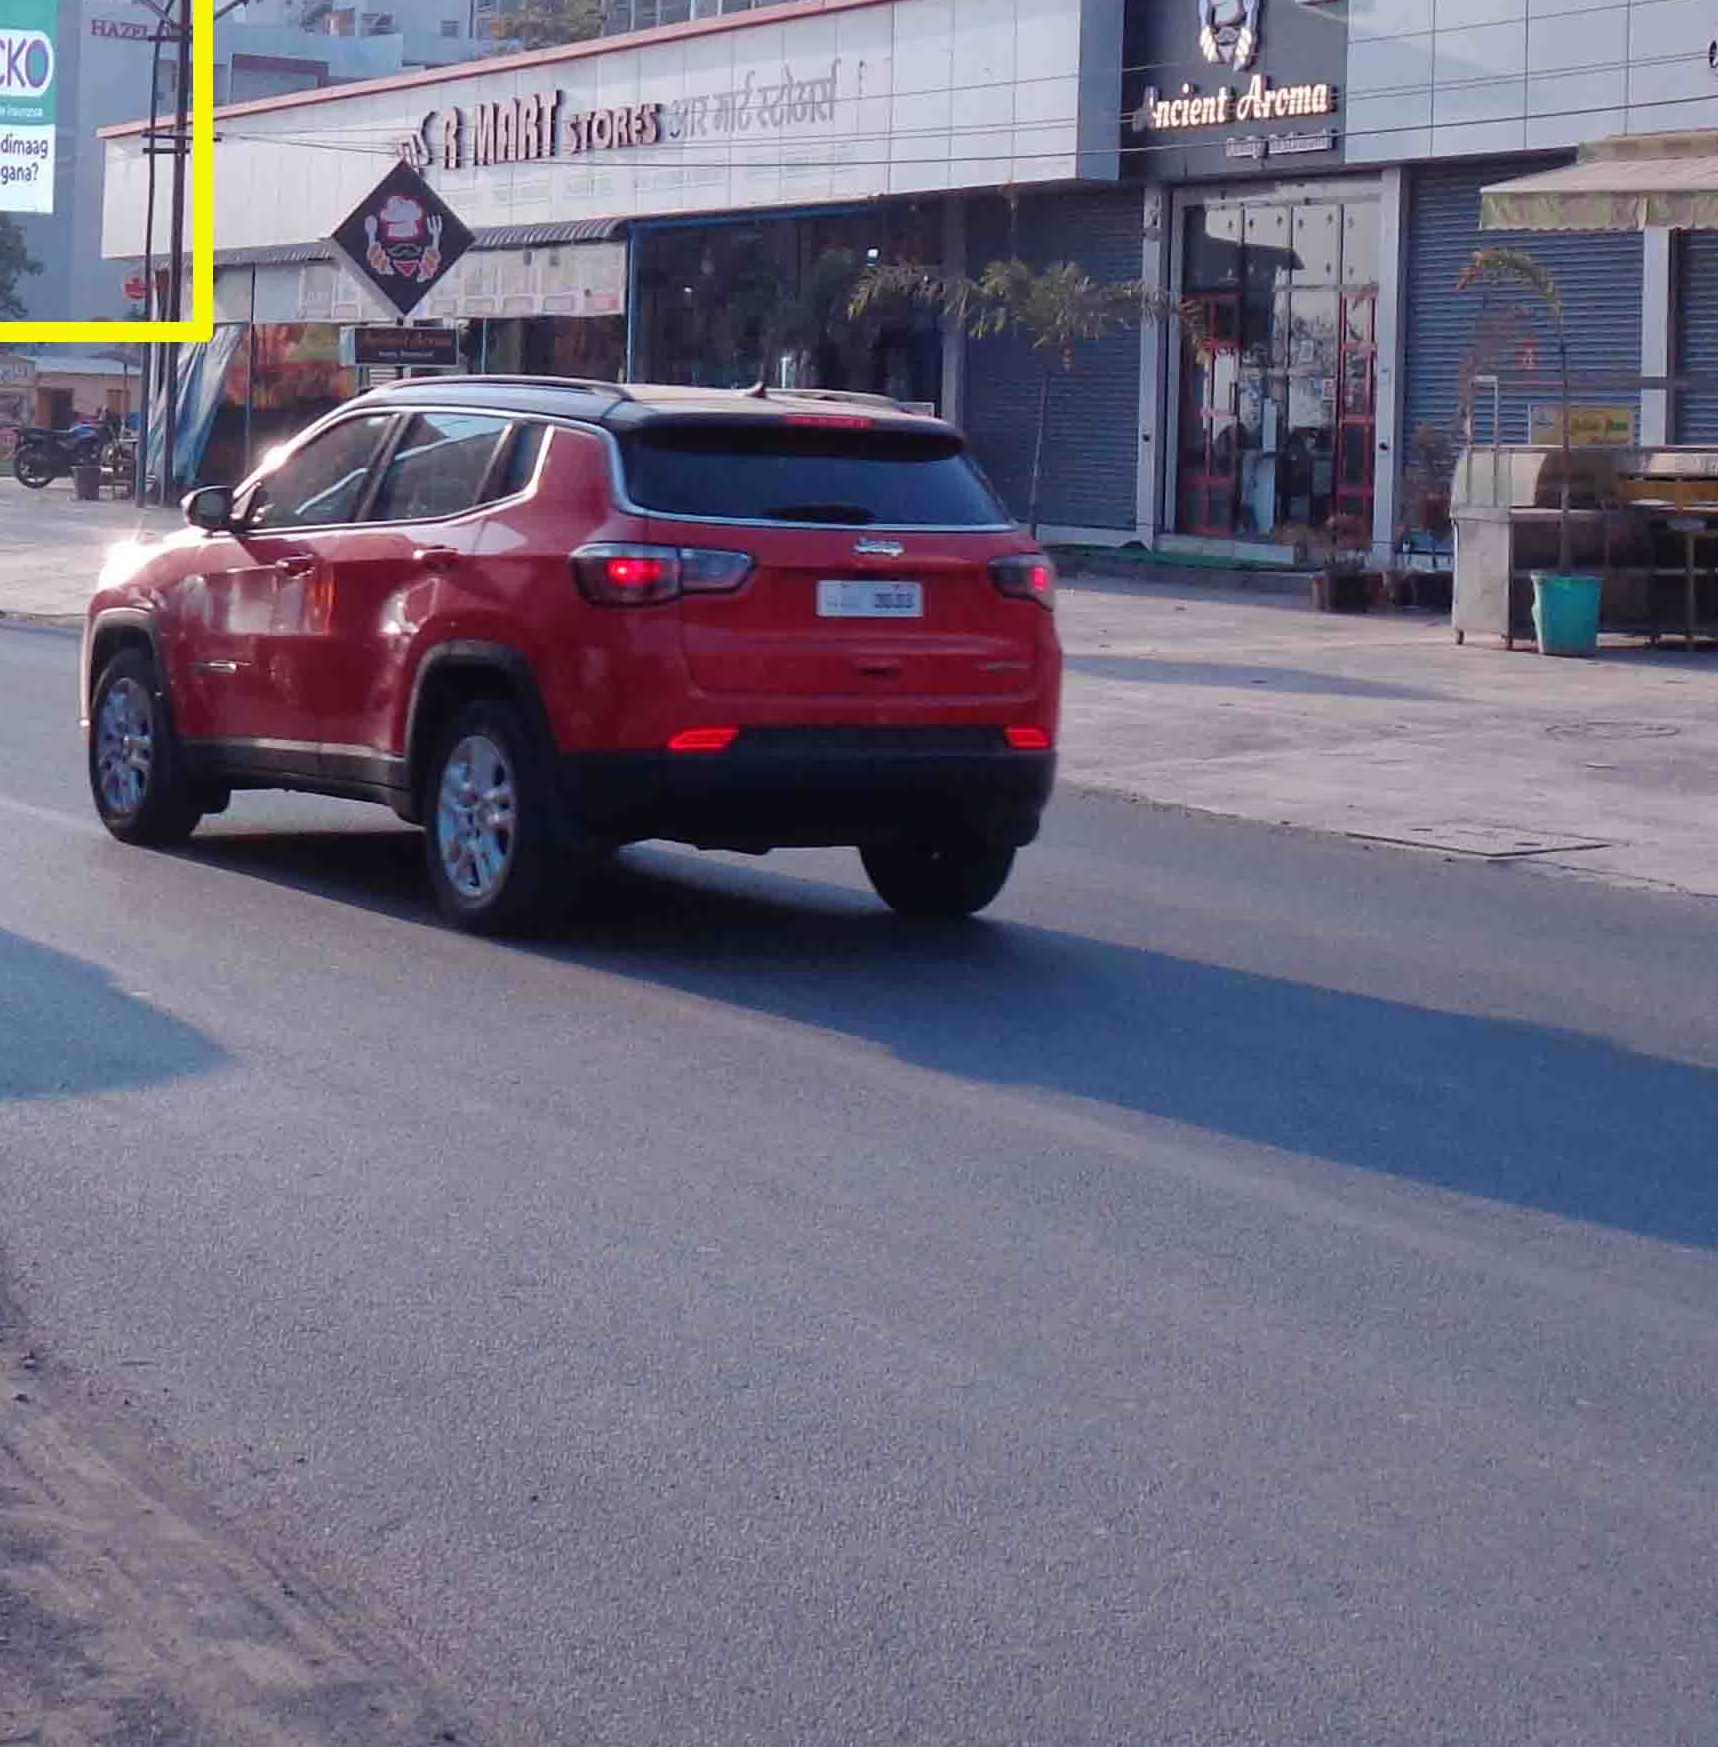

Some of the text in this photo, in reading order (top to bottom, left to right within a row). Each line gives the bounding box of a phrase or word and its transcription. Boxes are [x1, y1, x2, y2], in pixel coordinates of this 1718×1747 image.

[474, 90, 563, 166] MART
[566, 102, 665, 157] STORES
[1132, 74, 1329, 133] Ancient Aroma
[0, 133, 49, 160] dimaag
